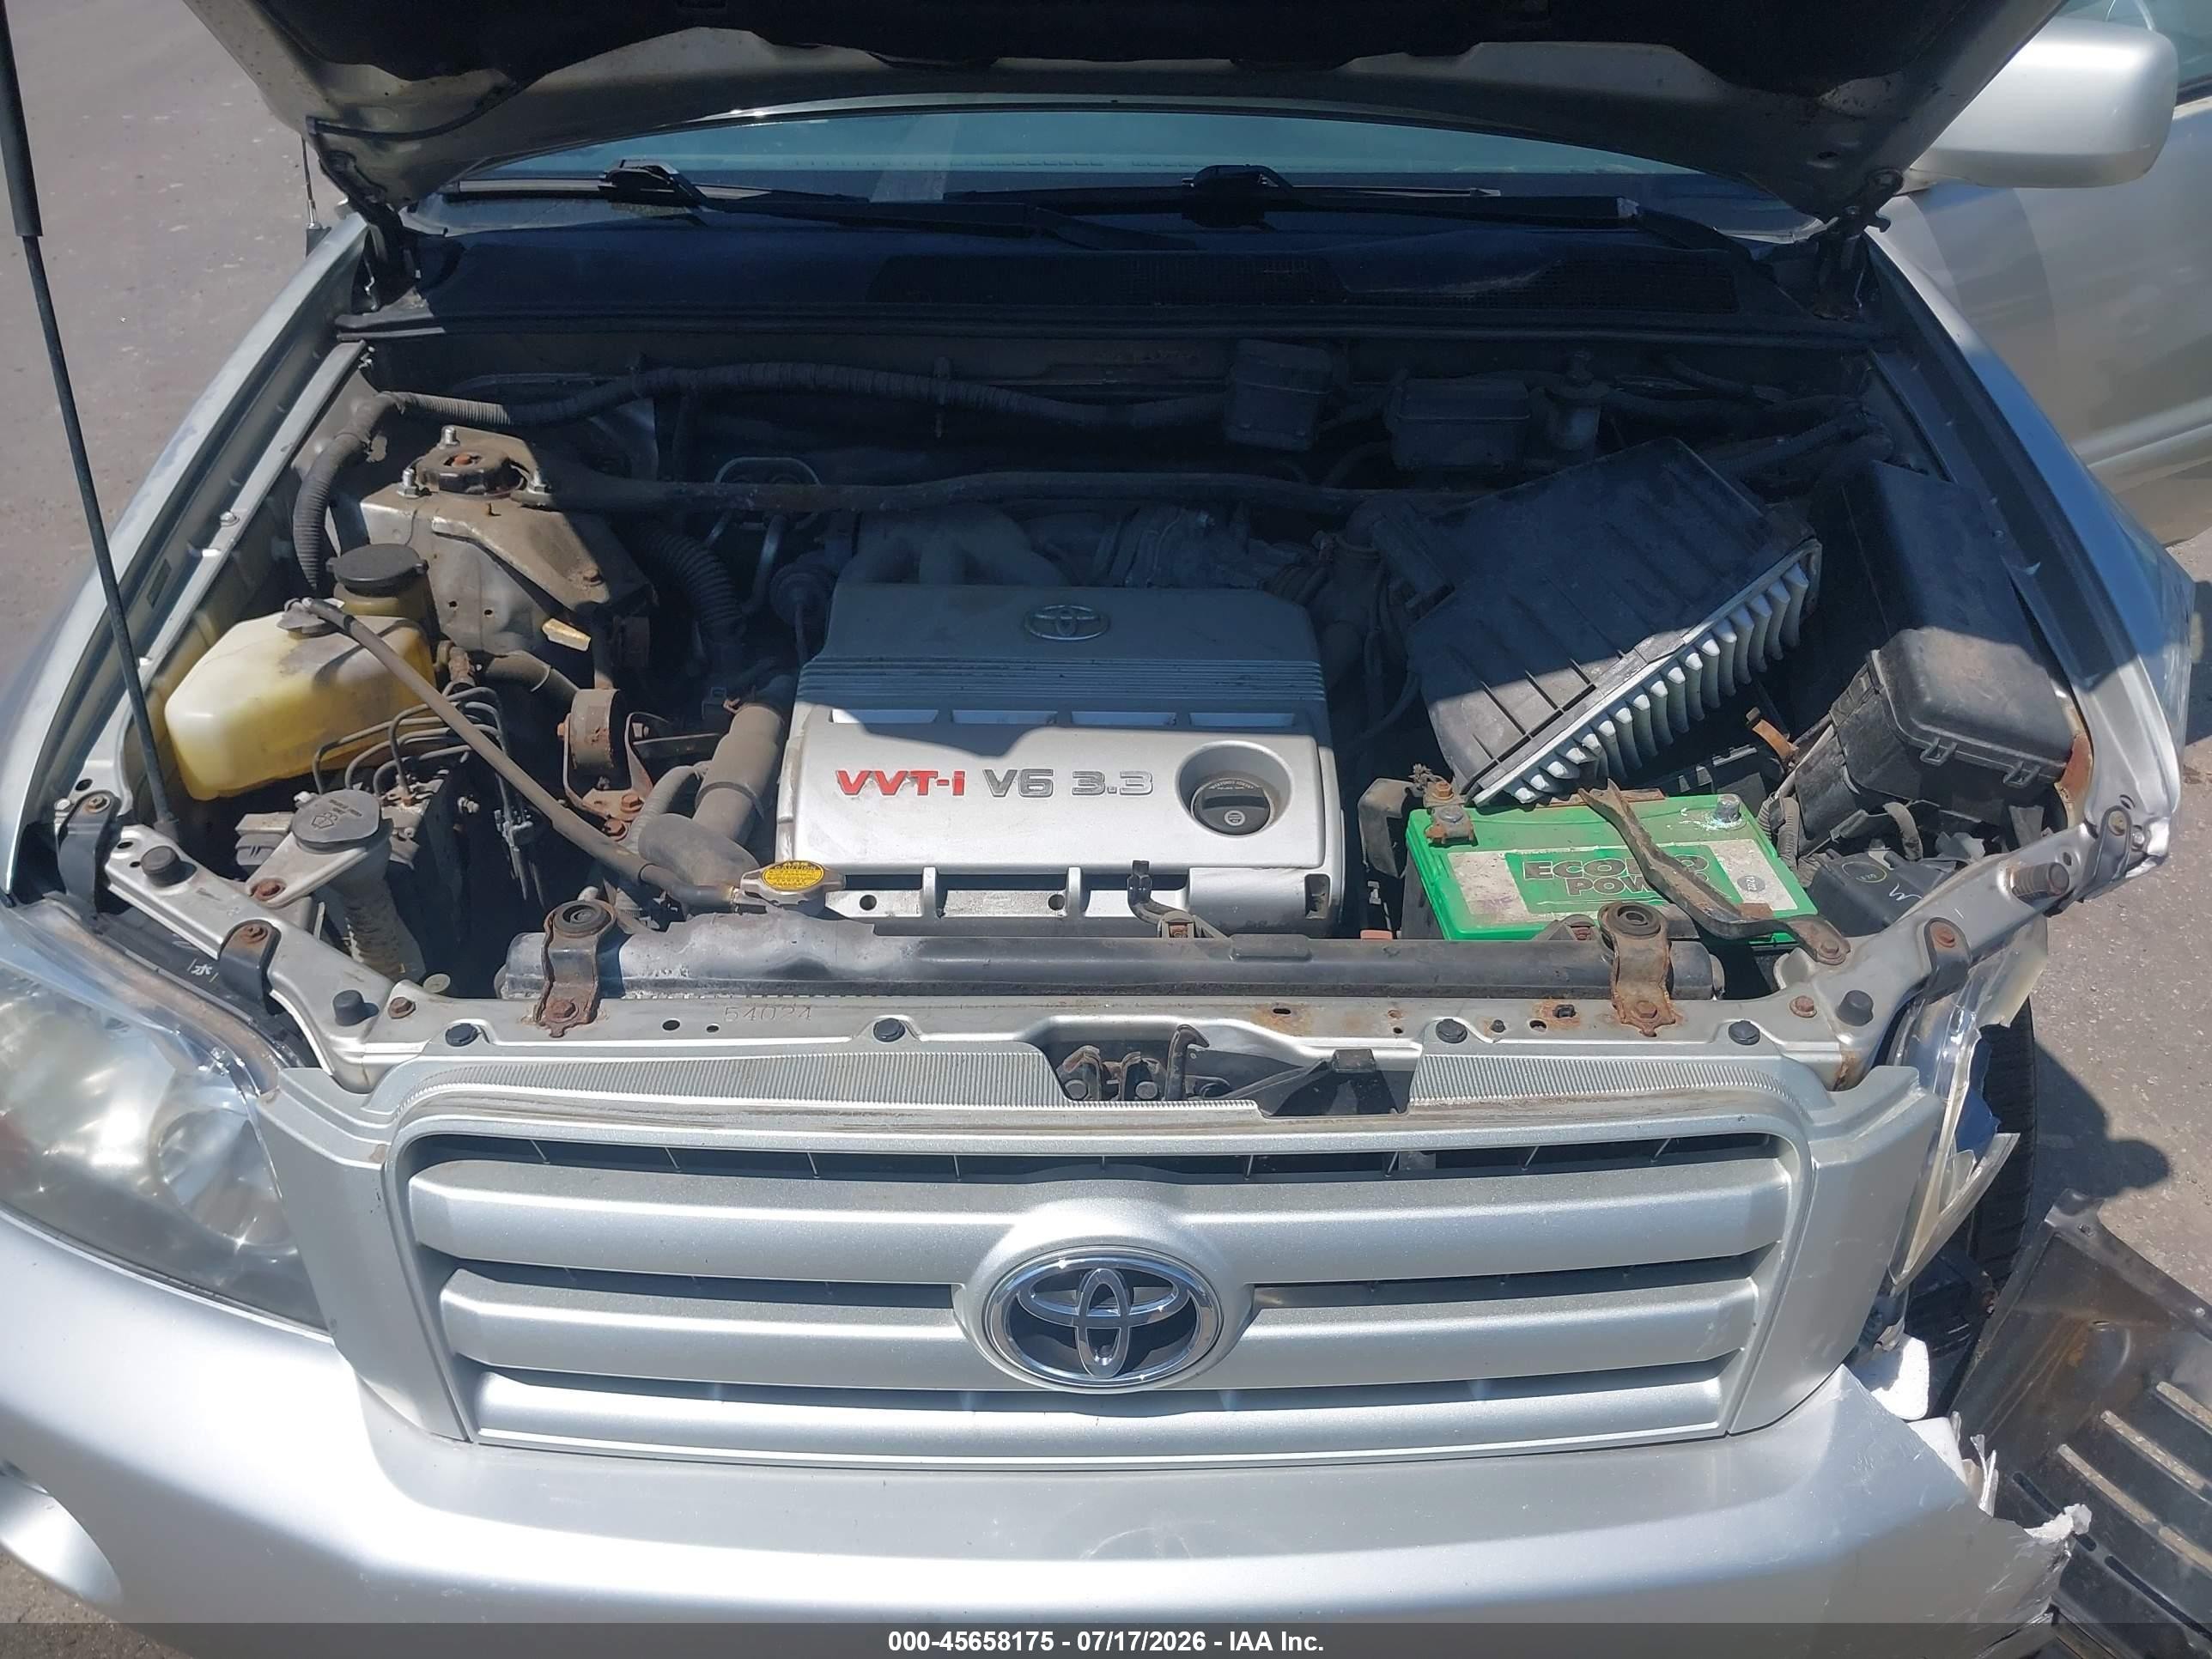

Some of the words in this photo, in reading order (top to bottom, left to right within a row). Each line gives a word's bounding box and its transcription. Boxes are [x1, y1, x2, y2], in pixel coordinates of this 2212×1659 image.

[835, 769, 966, 797] VVT-i
[981, 768, 1054, 798] V6
[1071, 770, 1153, 796] 3.3
